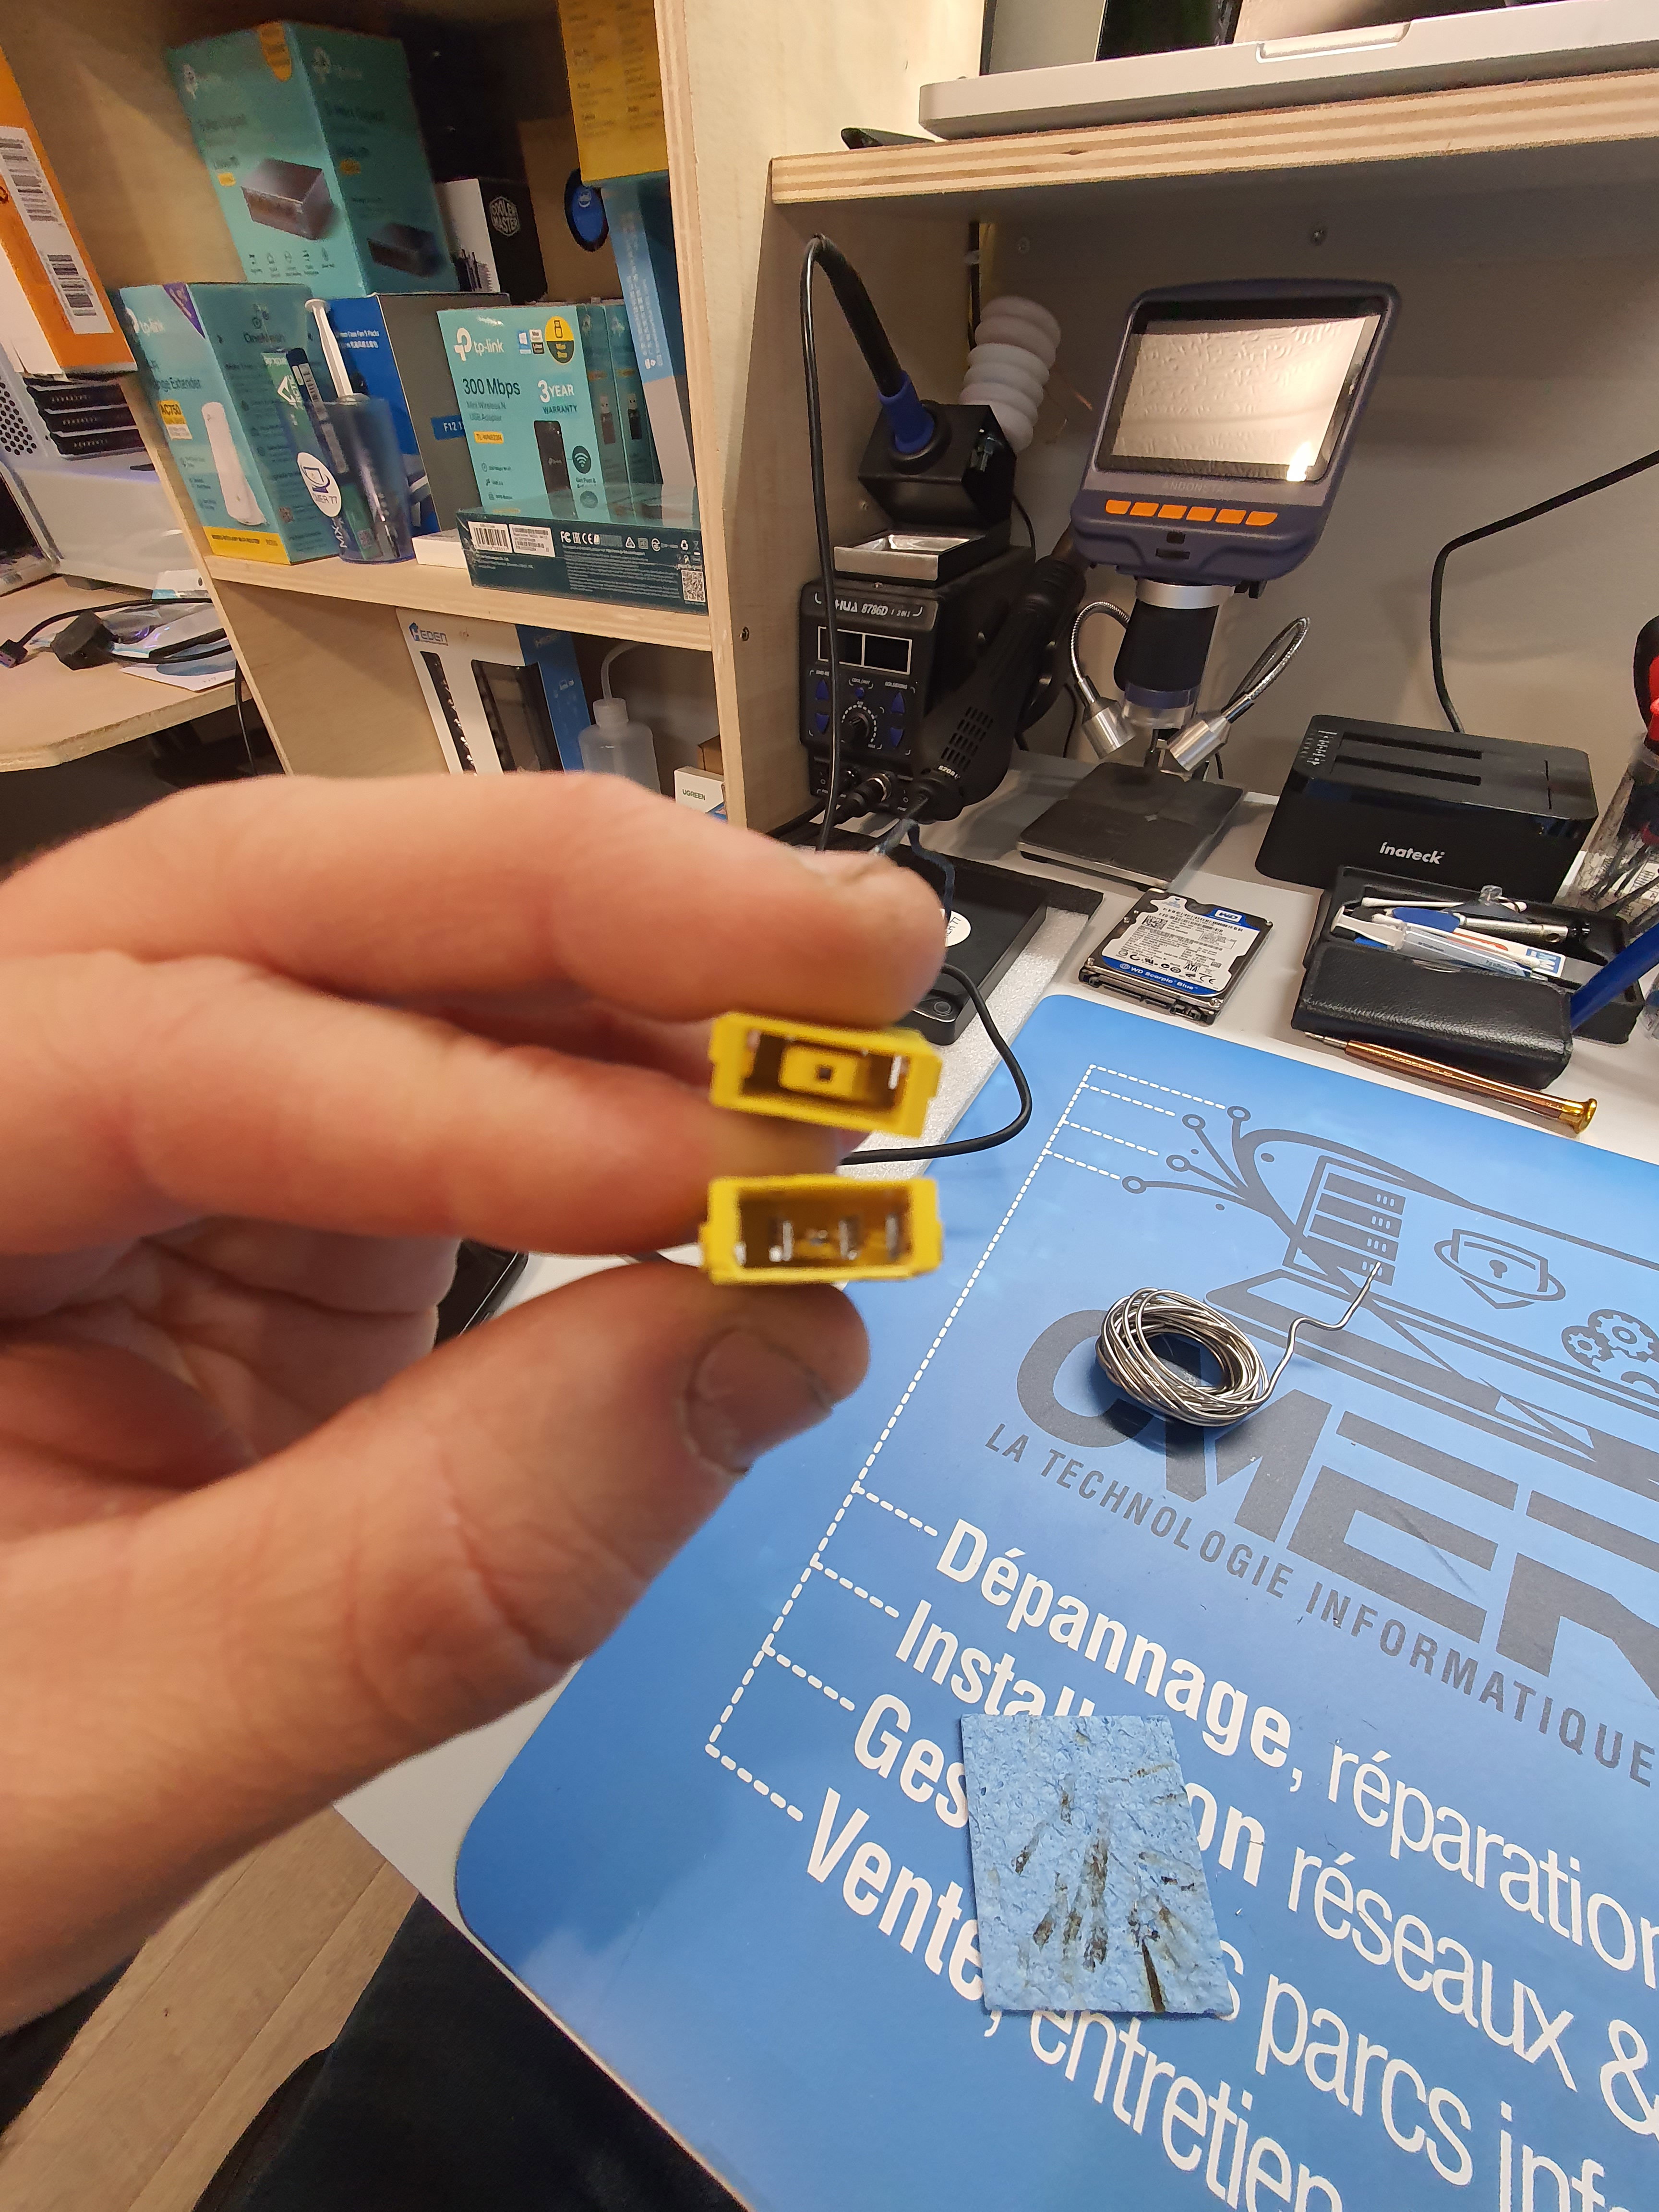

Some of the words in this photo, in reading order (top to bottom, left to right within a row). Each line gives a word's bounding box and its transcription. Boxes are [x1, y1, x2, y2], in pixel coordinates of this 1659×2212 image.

[473, 337, 505, 356] tp-link
[170, 376, 201, 390] Extender
[462, 378, 485, 395] 300
[486, 377, 520, 398] Mbps
[537, 380, 551, 403] 3
[548, 384, 575, 397] YEAR
[159, 404, 182, 416] AC750
[542, 405, 577, 415] WARRANTY
[443, 422, 457, 432] F12
[835, 599, 858, 613] HUA
[861, 603, 889, 616] 8786D
[682, 789, 706, 801] UGREEN
[1379, 842, 1443, 865] inateck
[1217, 911, 1238, 920] WD
[1130, 966, 1144, 974] WD
[1144, 971, 1174, 984] Scorpio
[1177, 982, 1194, 991] Blue
[985, 1423, 1030, 1463] LA
[1041, 1448, 1294, 1599] TECHNOLOGIE
[1305, 1581, 1656, 1788] INFORMATIQUE
[935, 1517, 1303, 1793] Dépannage,
[1287, 1846, 1578, 2092] réseaux
[1599, 2019, 1659, 2145] &
[1254, 1973, 1474, 2187] parcs
